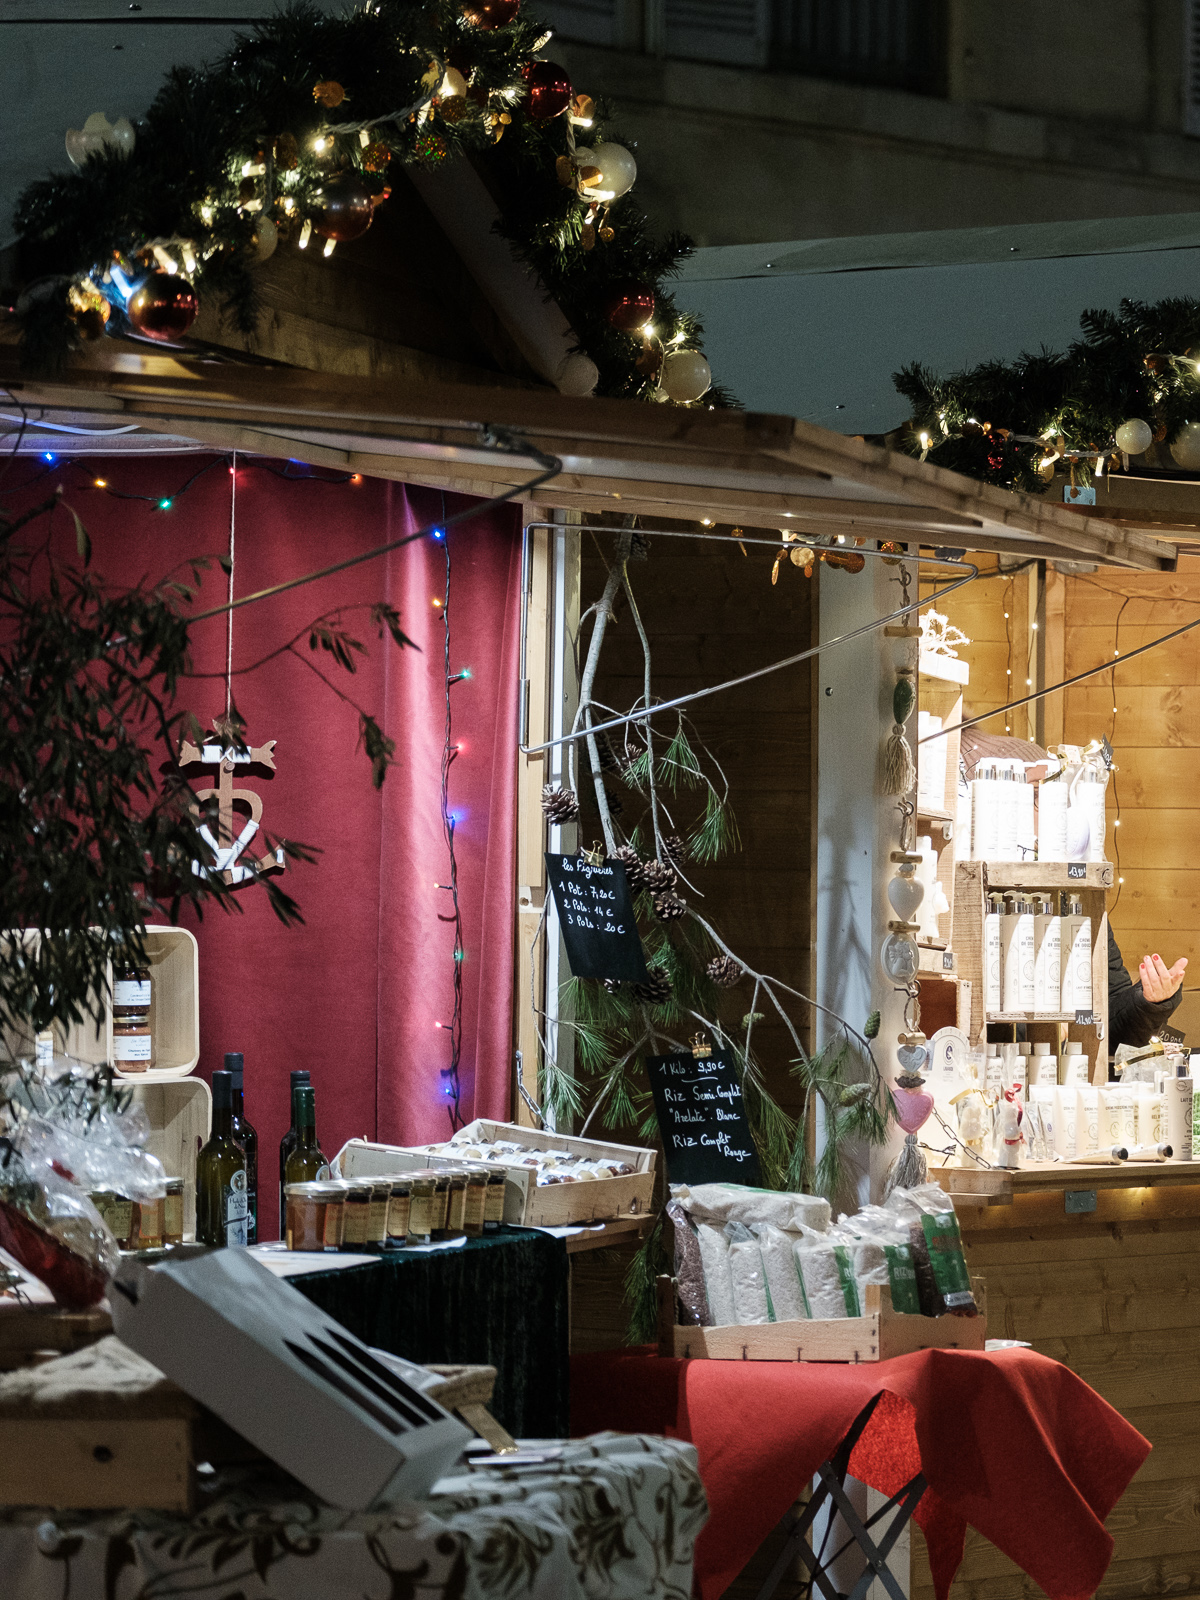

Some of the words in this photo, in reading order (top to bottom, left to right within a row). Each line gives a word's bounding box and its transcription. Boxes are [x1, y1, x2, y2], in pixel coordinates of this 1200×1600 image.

[559, 881, 566, 892] 1
[563, 898, 571, 909] 2
[567, 914, 574, 925] 3
[659, 1063, 667, 1075] 1
[664, 1088, 686, 1102] Riz
[716, 1108, 741, 1121] Blanc
[672, 1133, 698, 1148] Riz
[700, 1131, 731, 1152] Complet
[723, 1145, 752, 1162] Rouge
